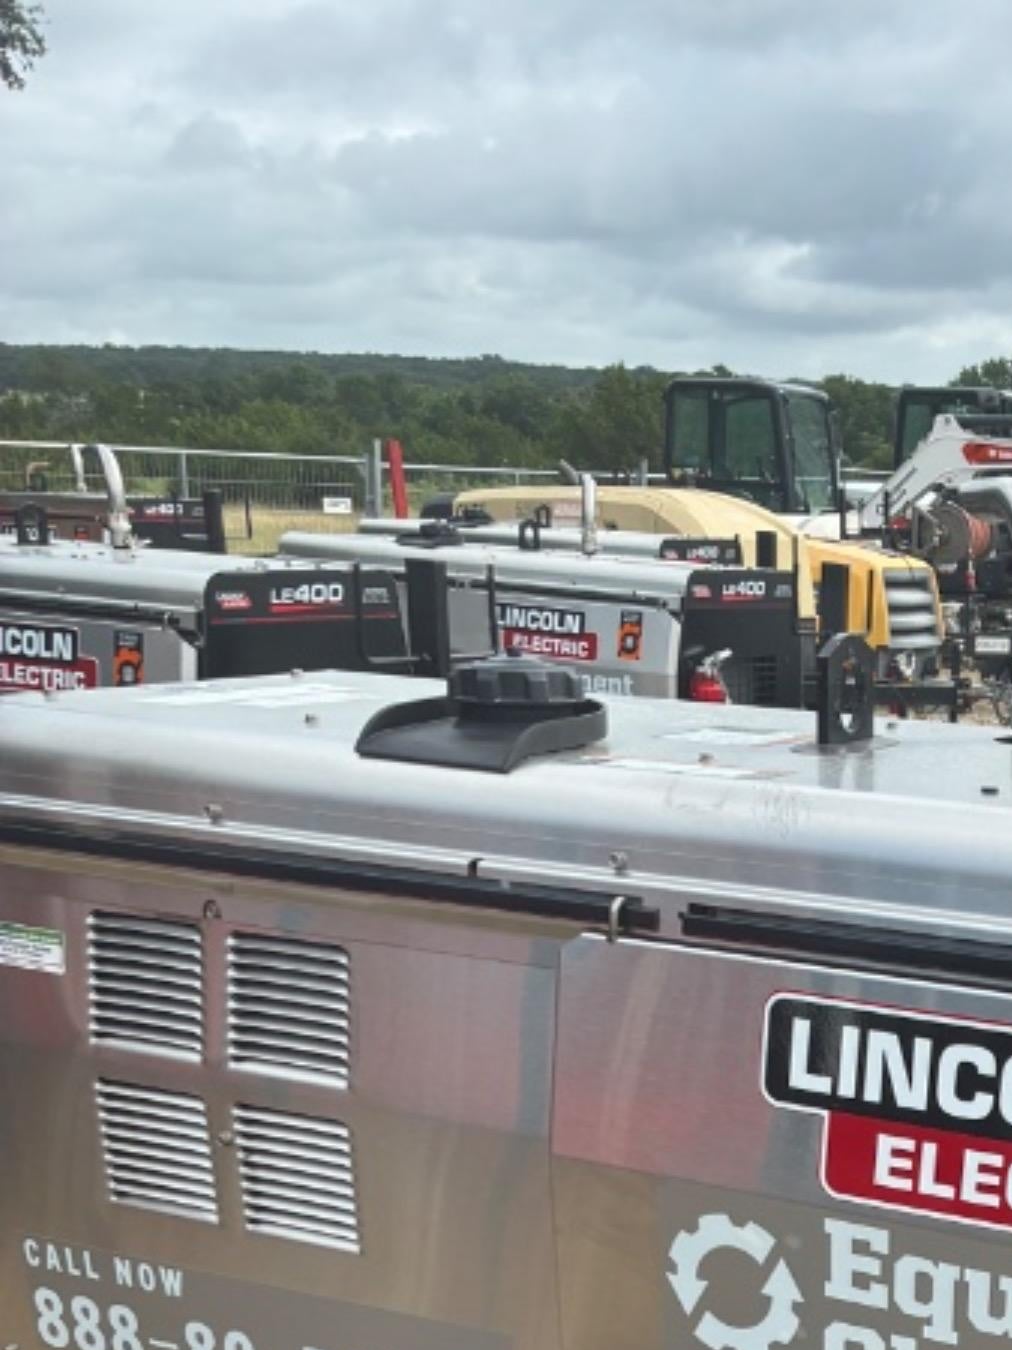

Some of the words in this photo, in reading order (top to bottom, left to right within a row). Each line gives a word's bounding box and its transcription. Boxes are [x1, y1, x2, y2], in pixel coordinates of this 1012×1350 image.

[271, 584, 343, 604] LE400
[23, 1238, 99, 1280] CALL
[114, 1256, 183, 1298] NOW
